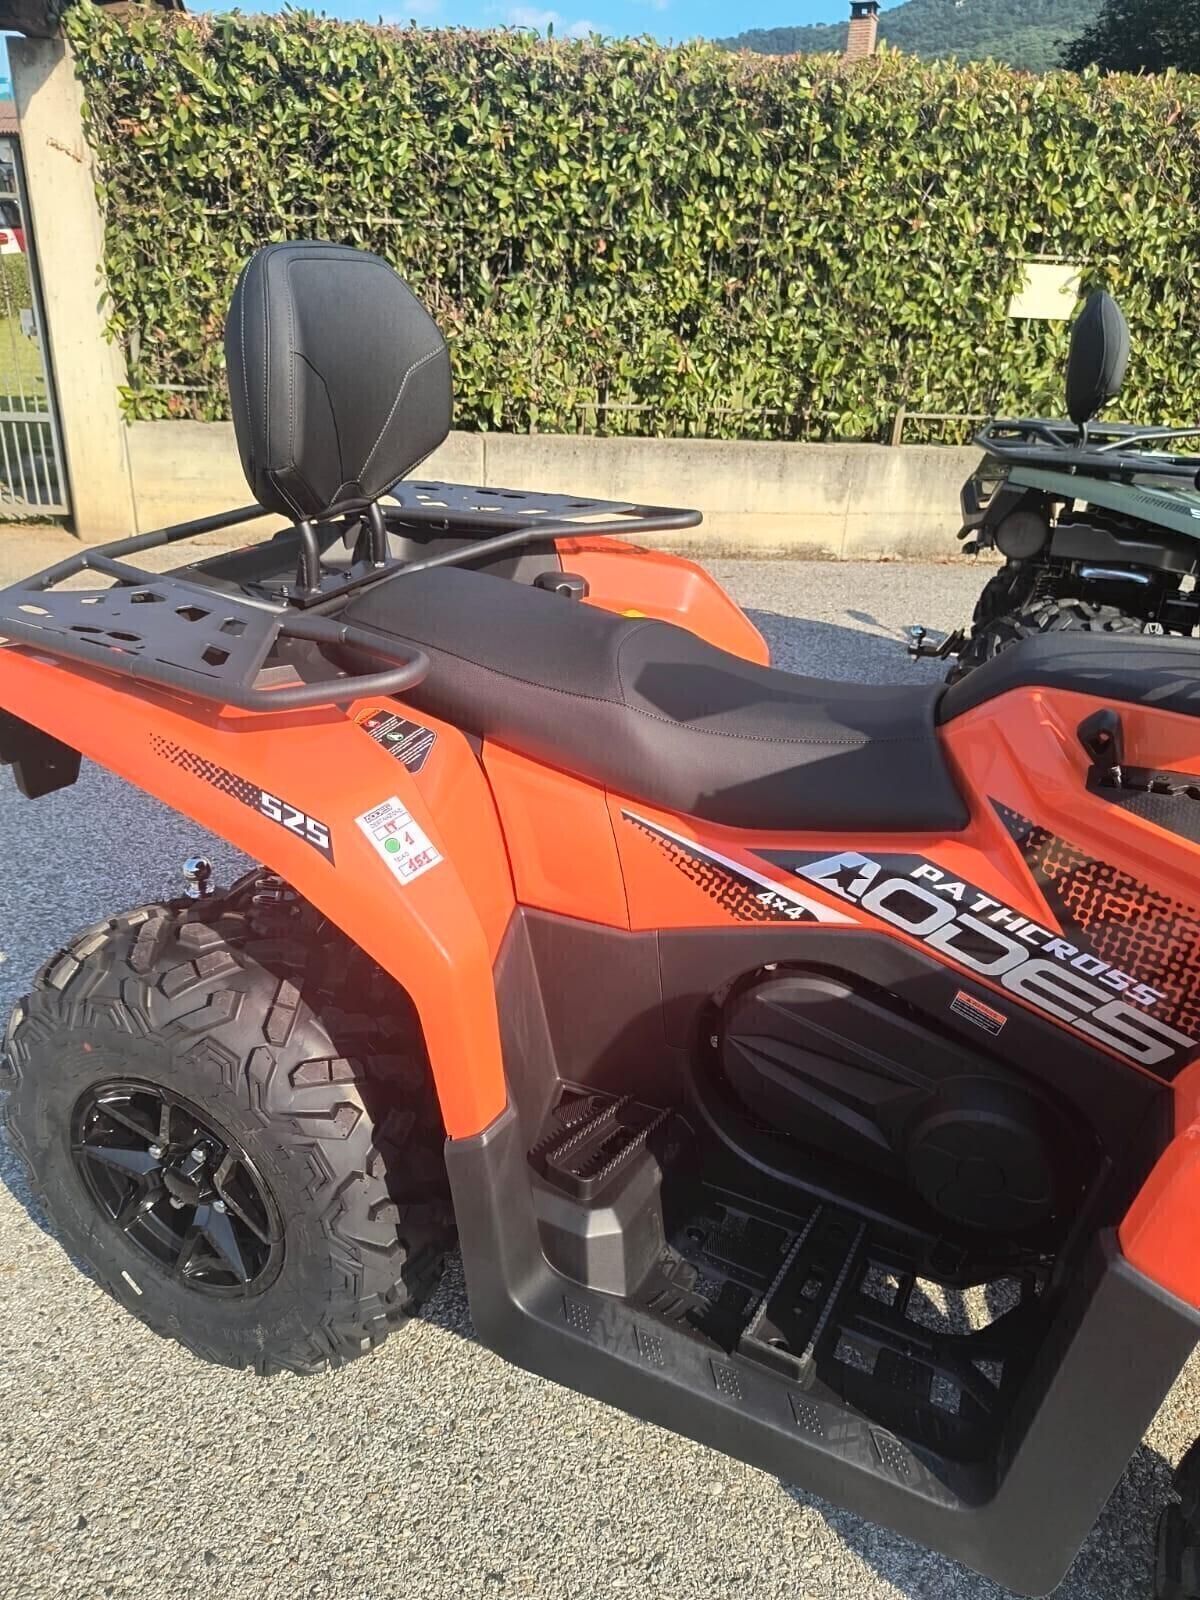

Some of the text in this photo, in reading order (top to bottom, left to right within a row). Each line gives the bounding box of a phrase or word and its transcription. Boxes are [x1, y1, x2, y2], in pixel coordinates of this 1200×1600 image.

[260, 791, 329, 849] 525
[795, 851, 1199, 1065] AODES
[909, 863, 1167, 1006] PATHCROSS
